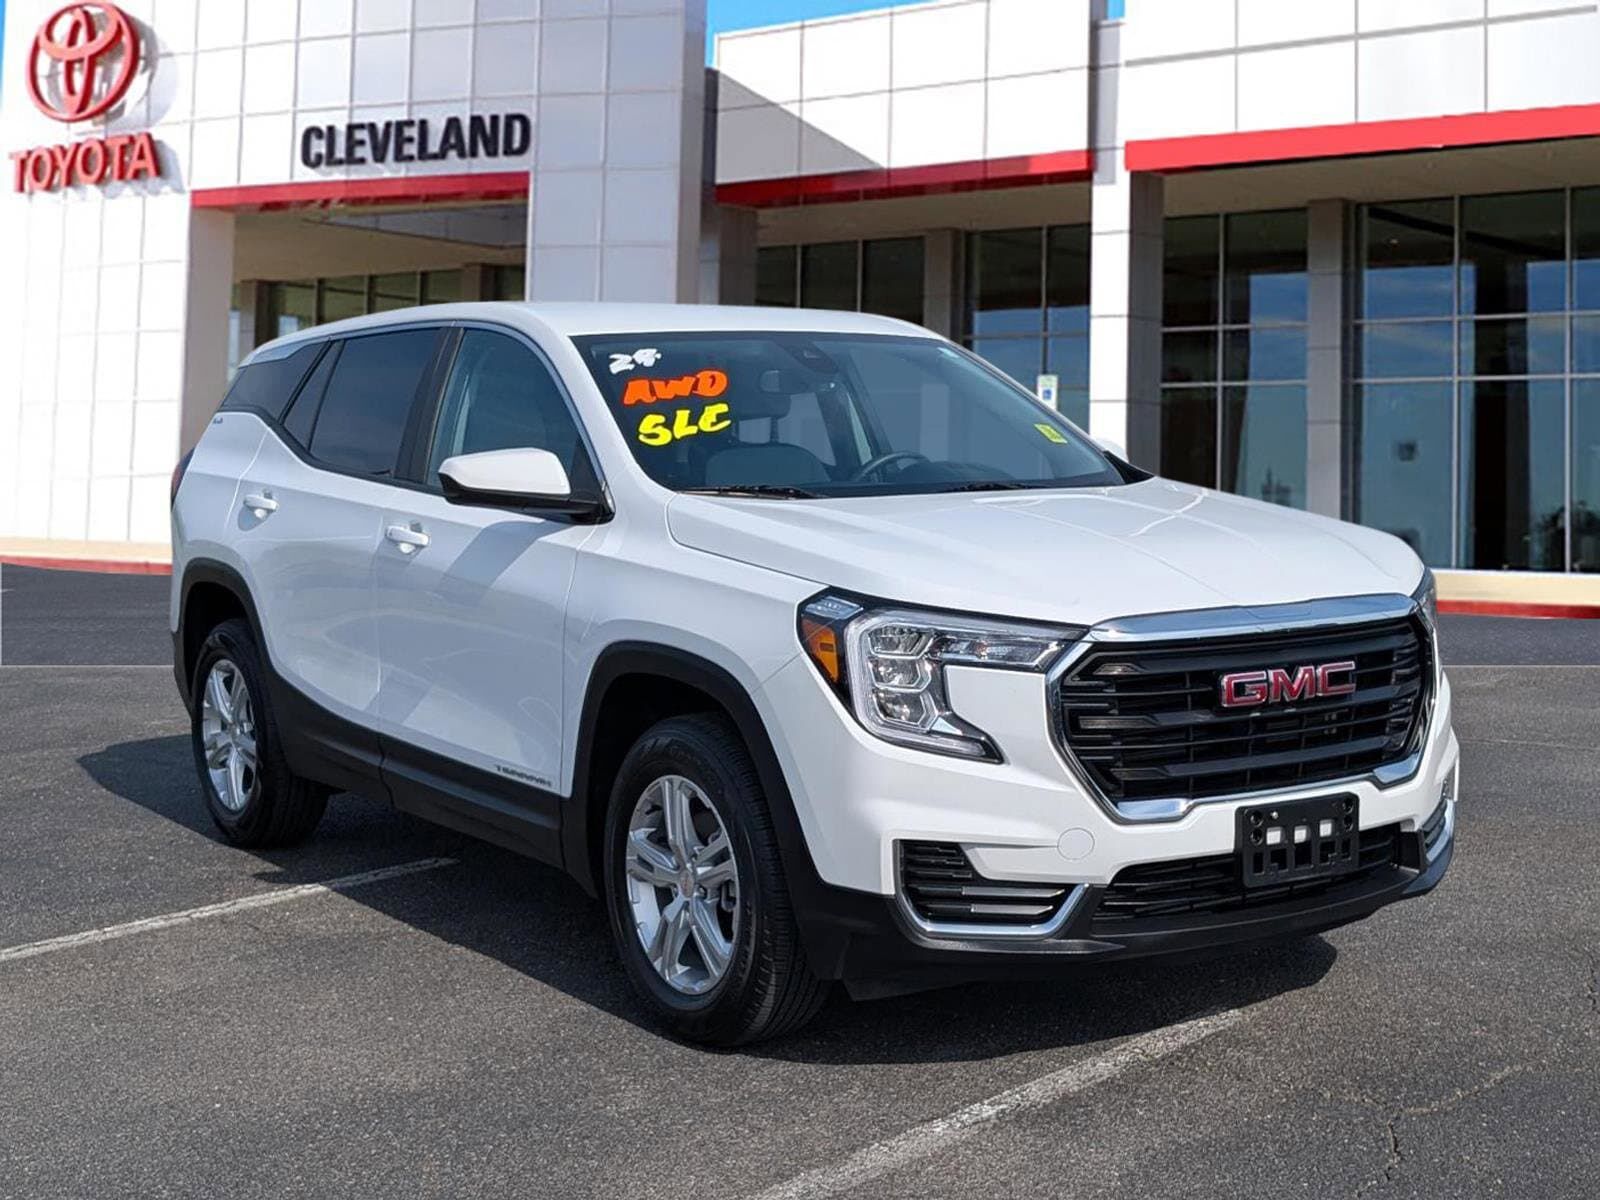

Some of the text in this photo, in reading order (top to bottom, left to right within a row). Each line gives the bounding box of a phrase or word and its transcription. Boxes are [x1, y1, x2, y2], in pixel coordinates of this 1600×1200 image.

[9, 131, 163, 194] TOYOTA
[301, 113, 532, 169] CLEVELAND
[622, 369, 729, 406] AWD
[638, 402, 732, 446] SLE
[1220, 660, 1357, 708] GMC
